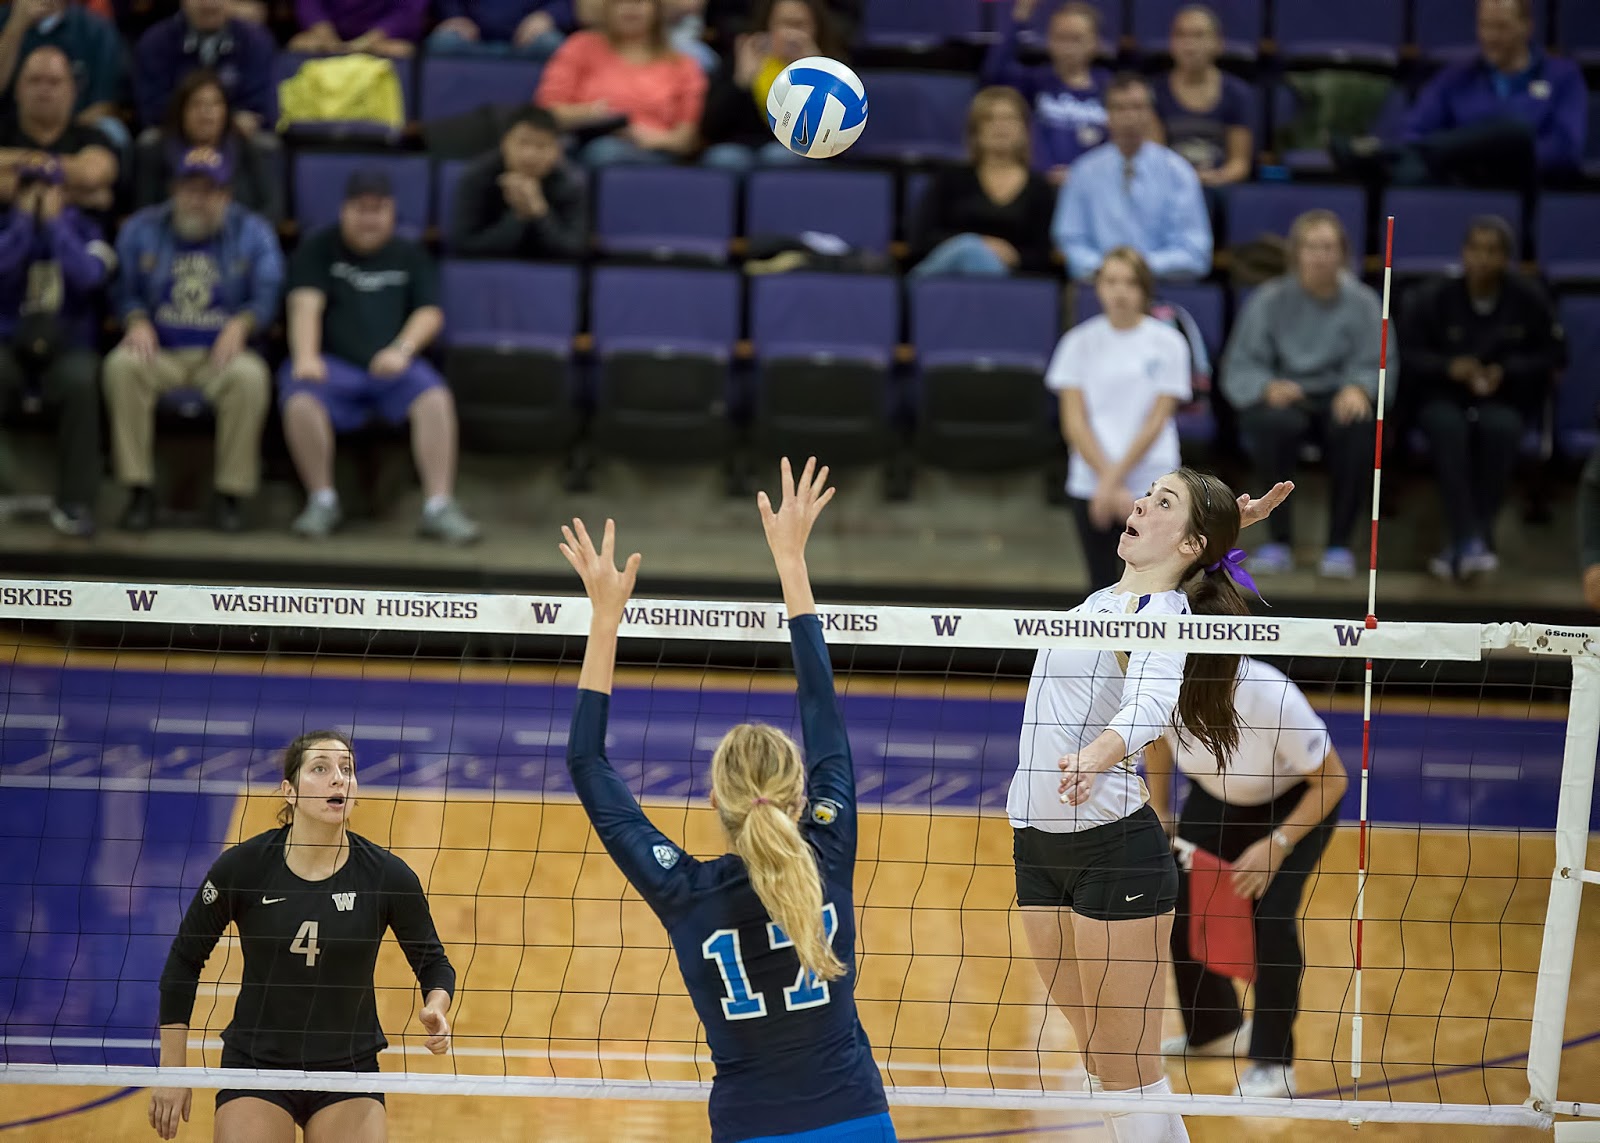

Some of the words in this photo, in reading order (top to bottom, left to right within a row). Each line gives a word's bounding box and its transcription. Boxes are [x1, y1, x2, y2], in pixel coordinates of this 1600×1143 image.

[0, 587, 72, 606] SKIES
[126, 589, 158, 611] W
[210, 593, 366, 615] WASHINGTON
[376, 599, 478, 619] HUSKIES
[531, 603, 562, 624] W
[777, 611, 878, 632] HKIES
[931, 615, 962, 637] W
[1014, 618, 1167, 639] WASHINGTON
[1178, 622, 1280, 641] HUSKIES
[1333, 624, 1365, 646] W
[331, 892, 357, 912] W
[289, 920, 321, 967] 4
